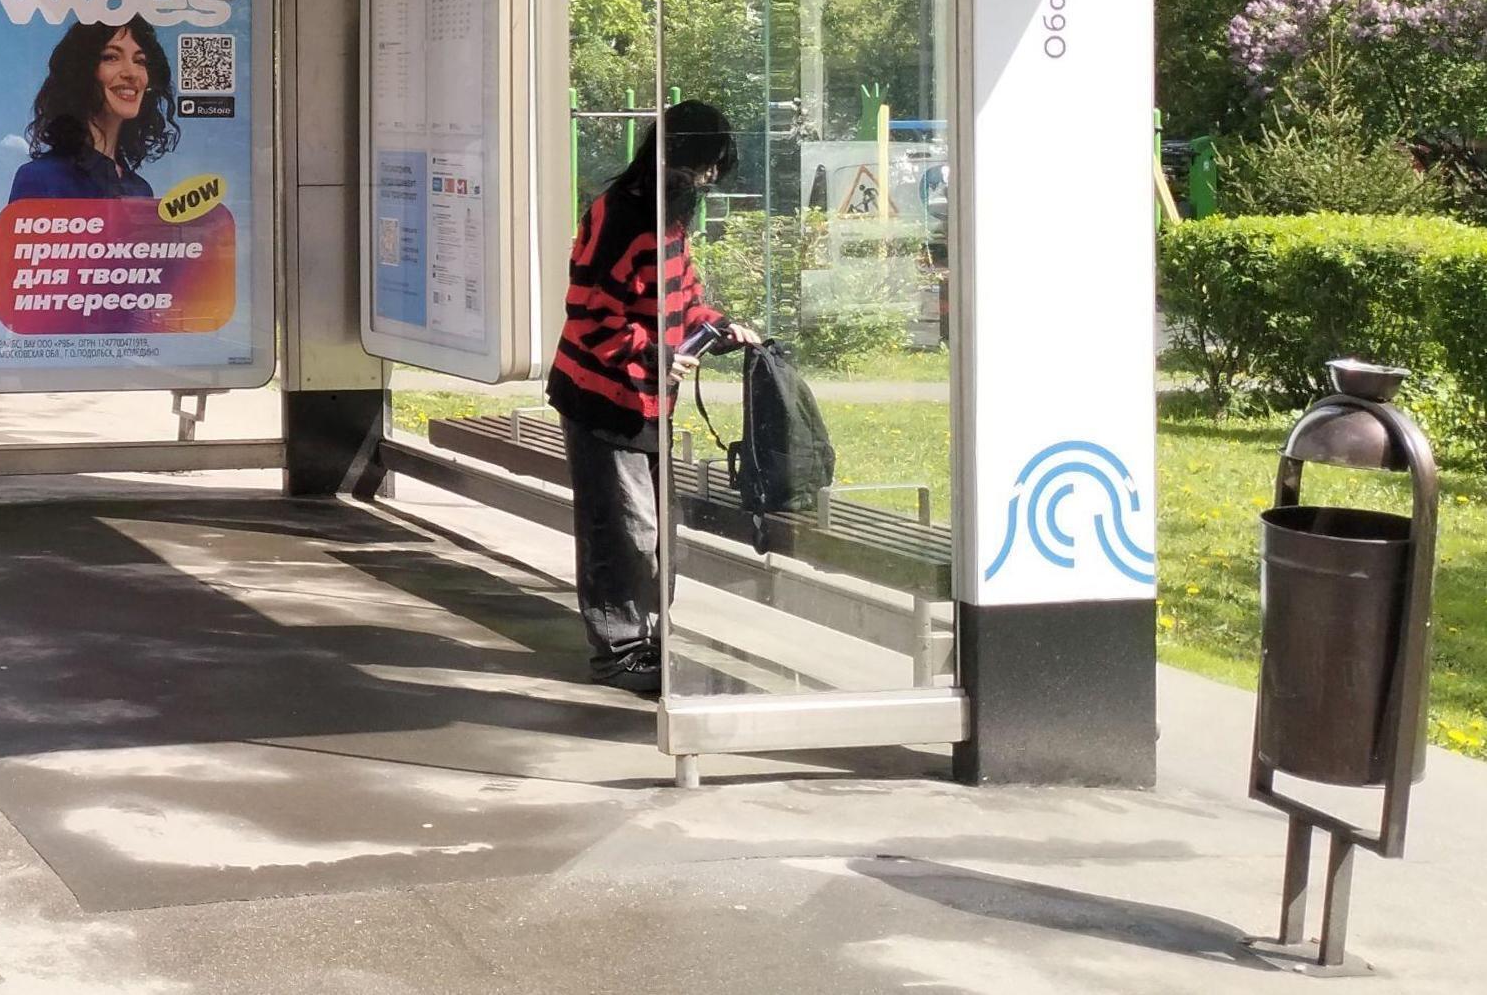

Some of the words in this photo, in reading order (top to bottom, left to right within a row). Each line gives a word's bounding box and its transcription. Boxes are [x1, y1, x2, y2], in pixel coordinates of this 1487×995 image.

[197, 106, 231, 115] RuStore
[14, 217, 105, 234] новое
[14, 242, 204, 266] приложение
[13, 268, 69, 289] для
[77, 268, 163, 285] твоих
[14, 293, 173, 316] интересов
